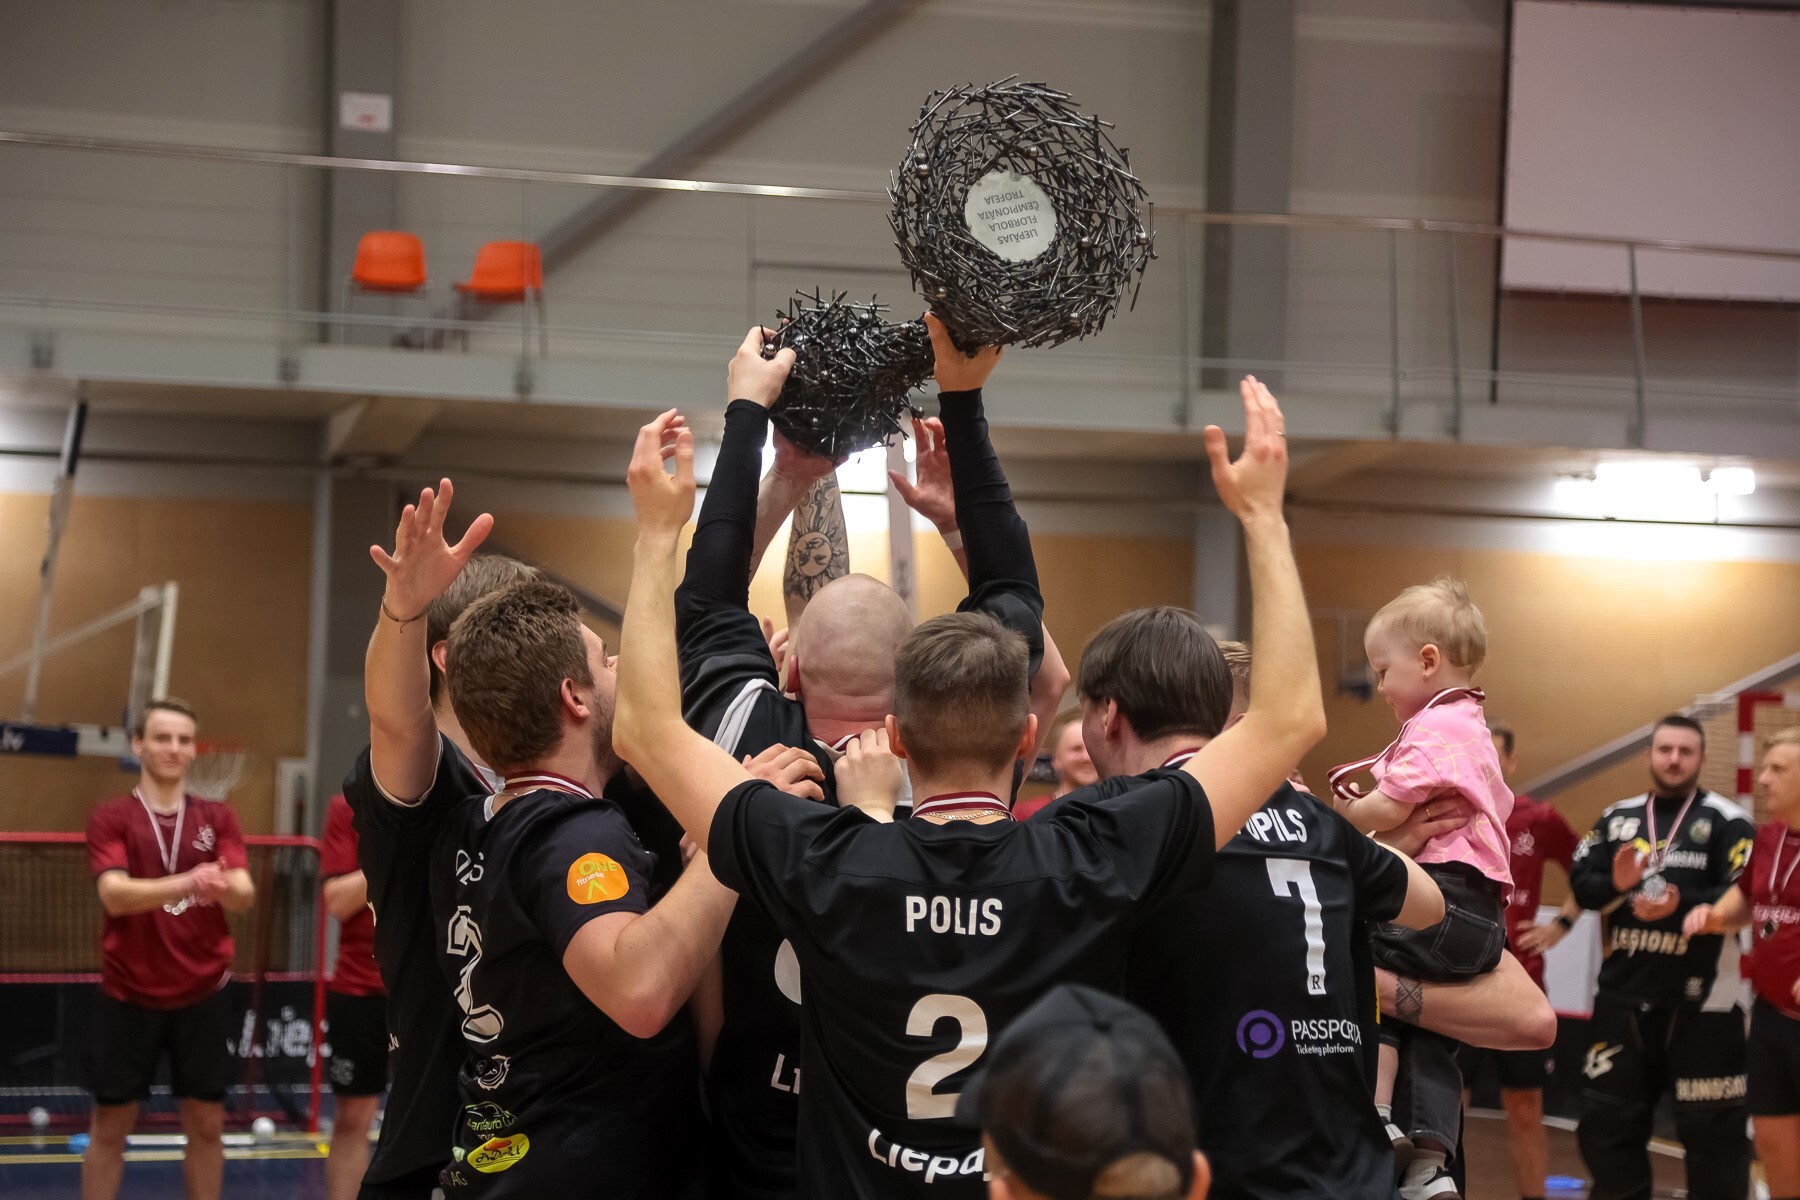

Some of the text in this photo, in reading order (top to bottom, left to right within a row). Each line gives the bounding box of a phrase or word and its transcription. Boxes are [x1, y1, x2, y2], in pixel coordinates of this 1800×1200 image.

[983, 190, 1025, 205] TROFEJA
[977, 200, 1040, 221] ČEMPIONĀTA
[988, 215, 1038, 232] FLORBOLA
[997, 229, 1039, 245] LIEPĀJAS
[1237, 807, 1308, 843] UPILS
[579, 861, 618, 875] ONE
[576, 871, 605, 886] fitness
[905, 895, 1003, 936] POLIS
[1265, 857, 1327, 995] 7
[905, 993, 989, 1120] 2
[1296, 1042, 1355, 1057] Ticketing platform
[867, 1128, 994, 1184] Liepa
